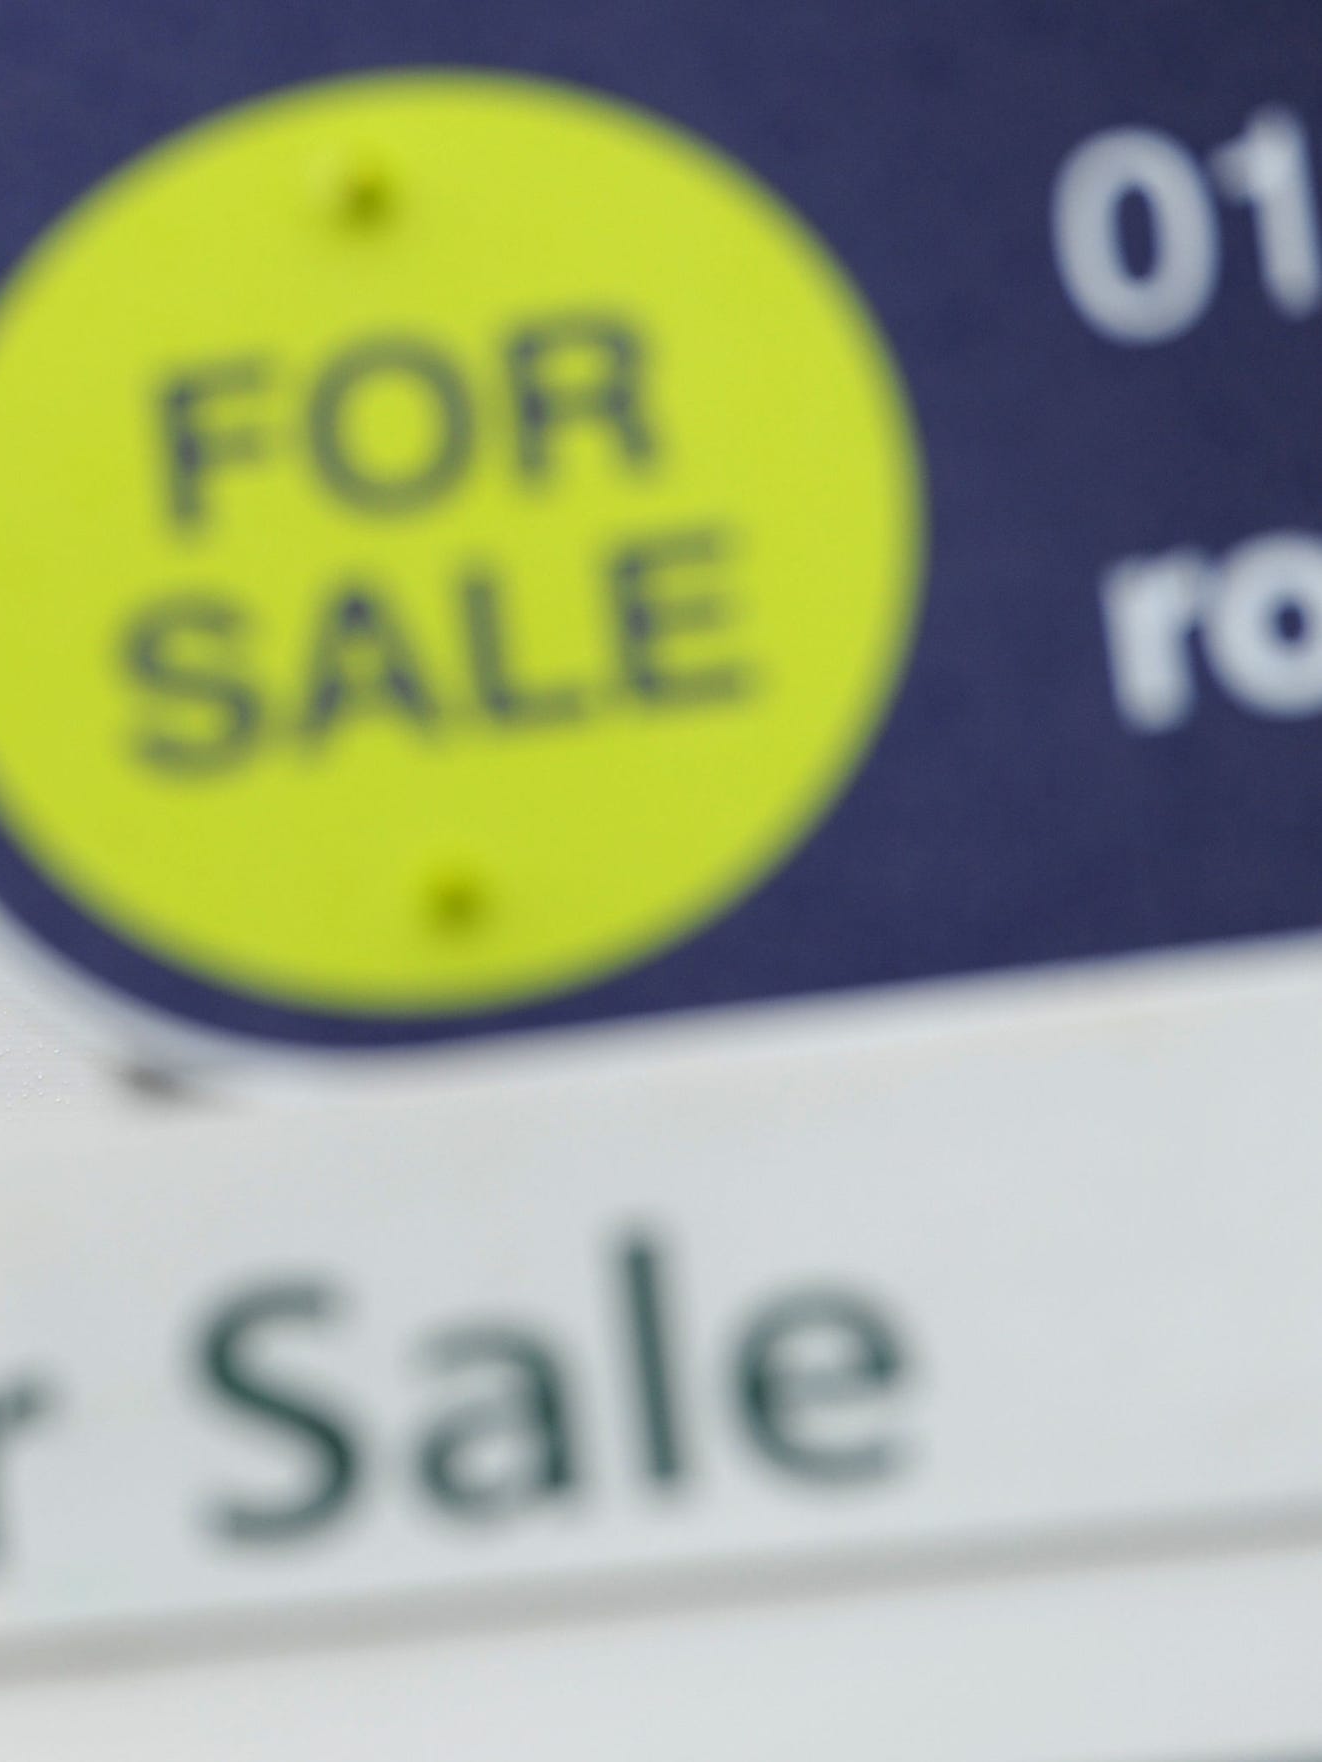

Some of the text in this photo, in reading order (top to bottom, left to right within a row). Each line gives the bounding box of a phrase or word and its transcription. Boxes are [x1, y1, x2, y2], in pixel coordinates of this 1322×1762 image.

[150, 312, 663, 537] FOR
[116, 524, 758, 774] SALE
[184, 1222, 914, 1550] Sale
